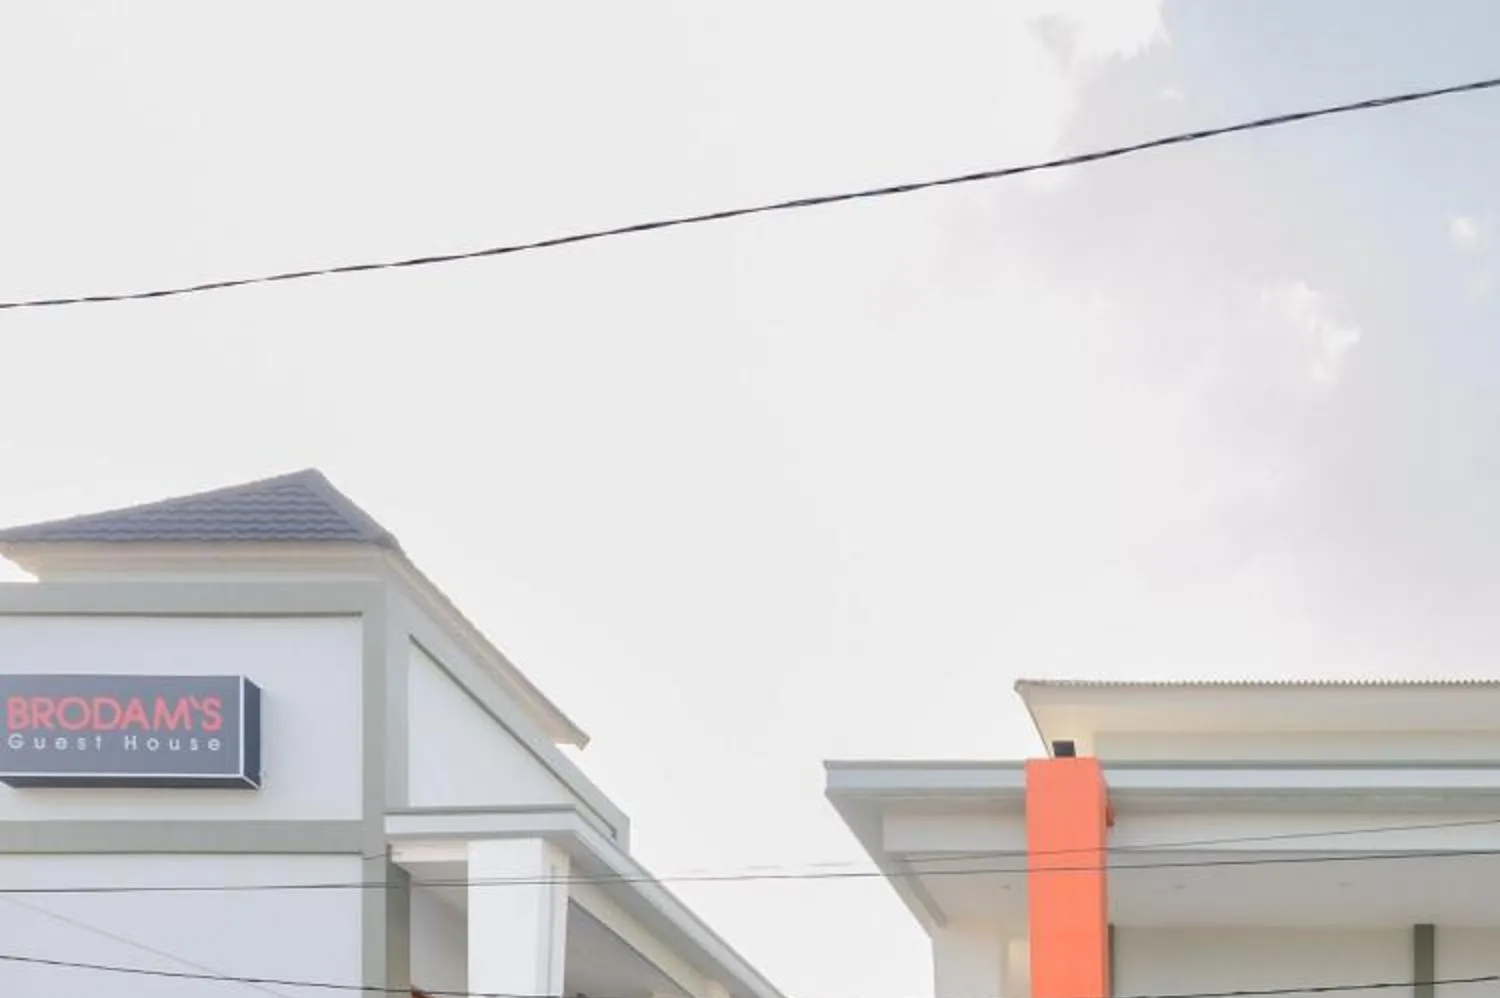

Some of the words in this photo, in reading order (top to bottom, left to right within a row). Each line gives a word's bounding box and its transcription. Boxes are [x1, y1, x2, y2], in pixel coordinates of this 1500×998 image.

[6, 696, 223, 731] BRODAM'S
[7, 733, 102, 751] Guest
[123, 735, 221, 751] House
